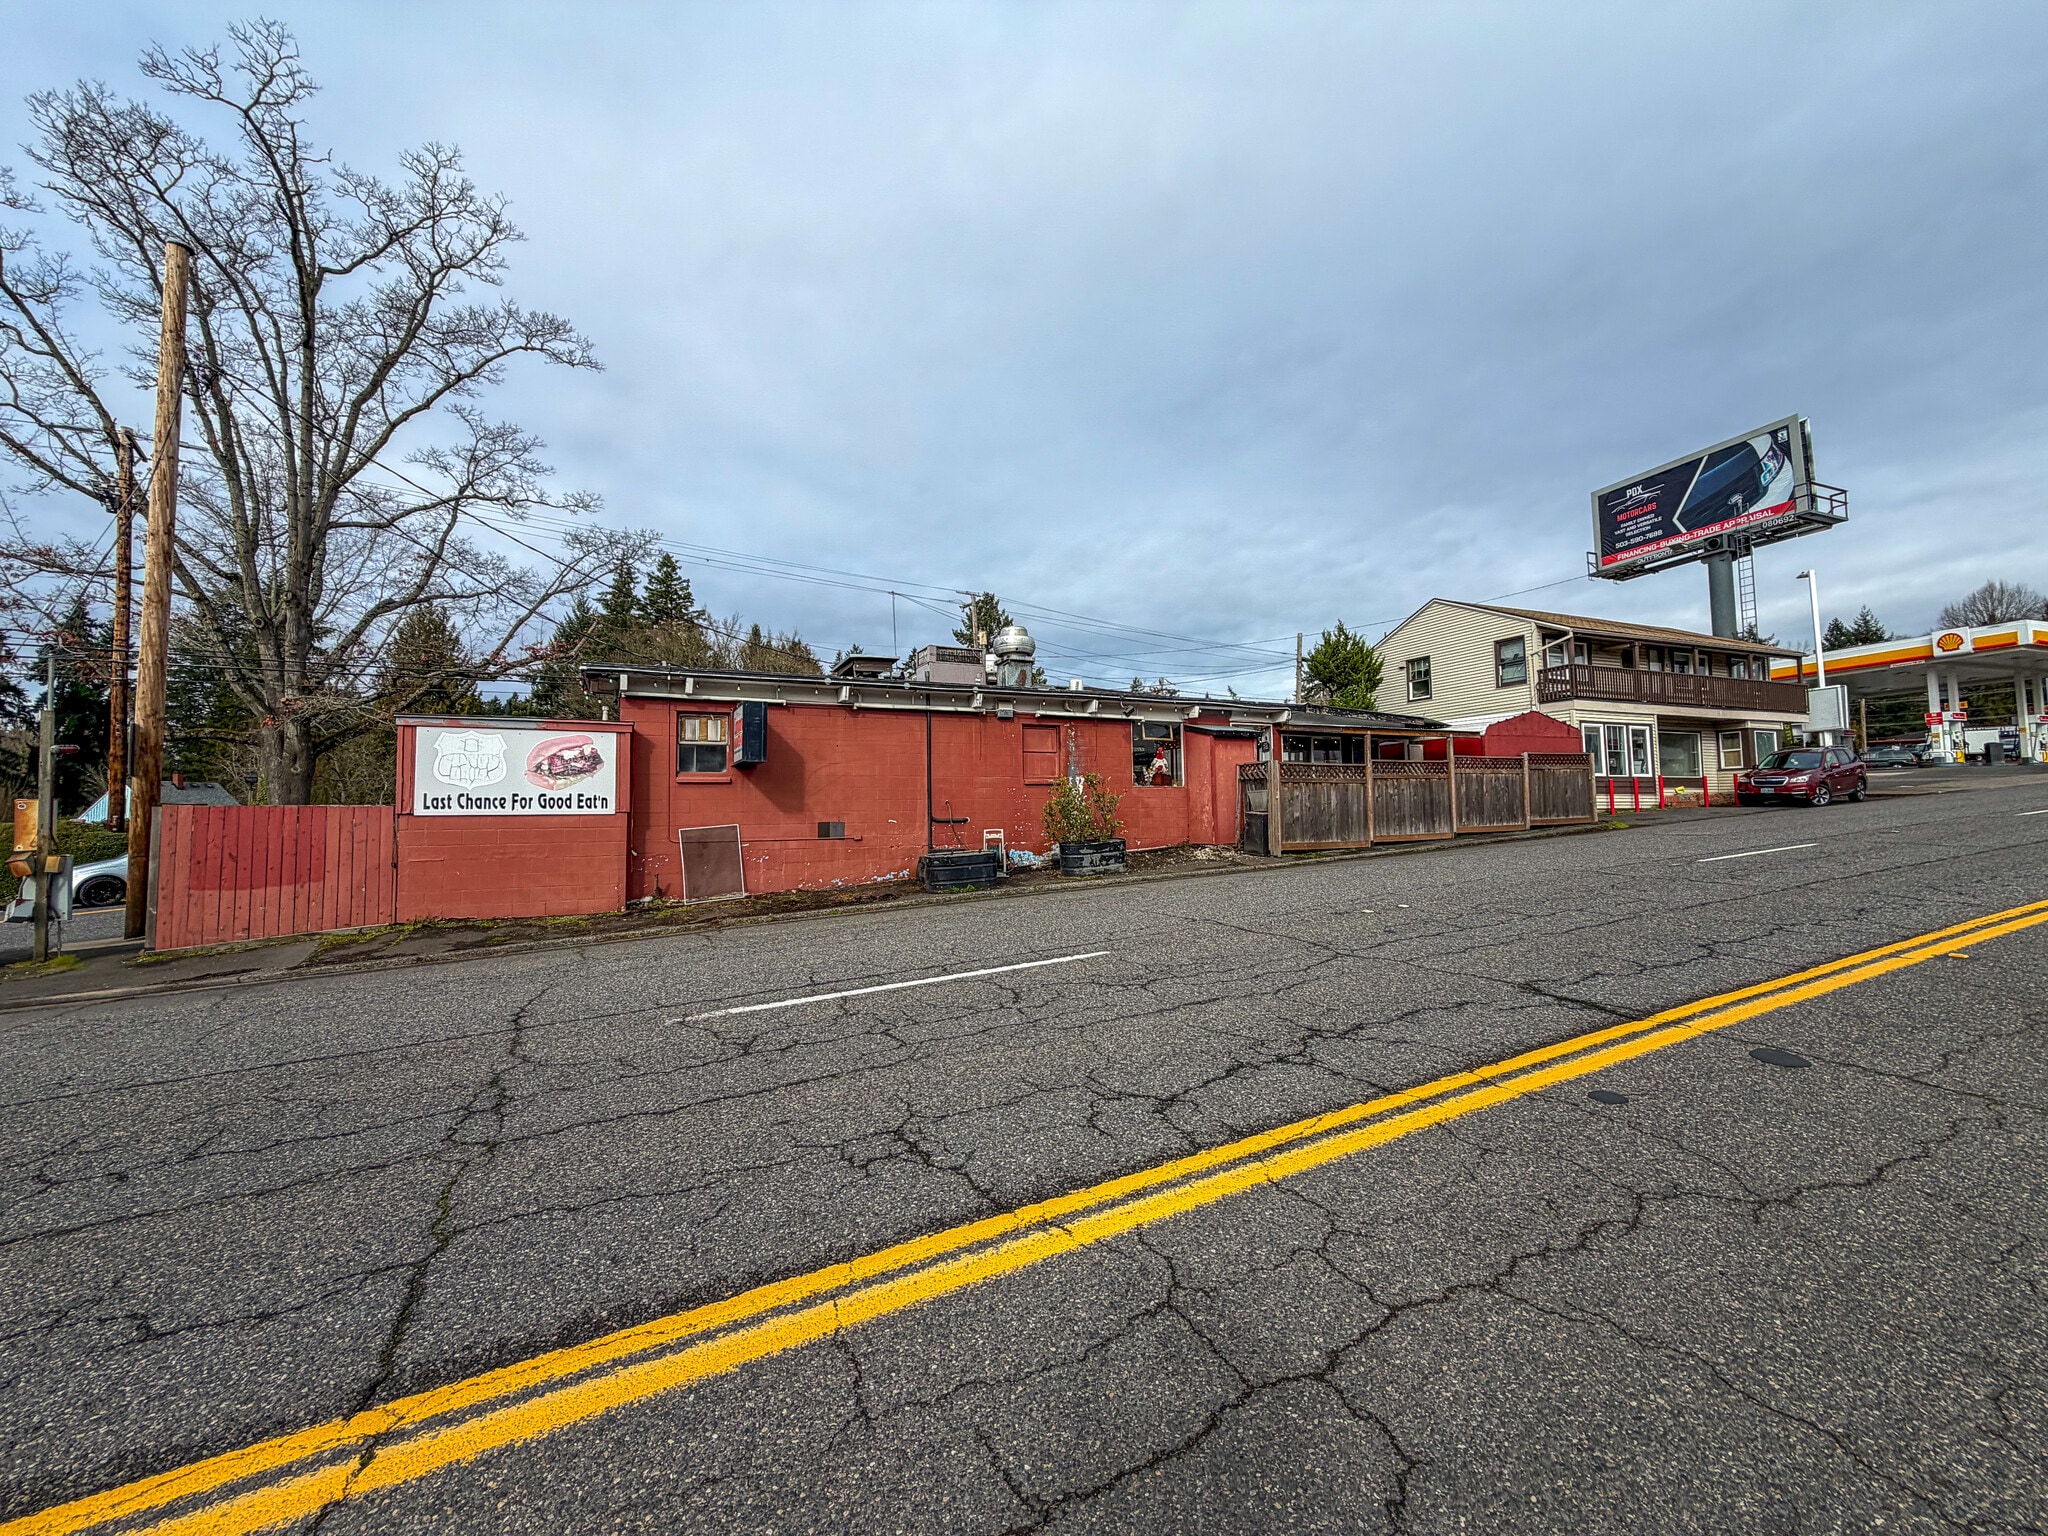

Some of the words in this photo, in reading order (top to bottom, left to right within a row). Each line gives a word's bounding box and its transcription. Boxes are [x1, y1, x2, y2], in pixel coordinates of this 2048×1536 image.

[1626, 484, 1643, 498] PDX
[1616, 502, 1657, 522] MOTORCARS
[423, 793, 452, 810] Last
[457, 793, 506, 810] Chance
[511, 793, 534, 811] For
[538, 793, 572, 810] Good
[577, 793, 608, 810] Eat'n
